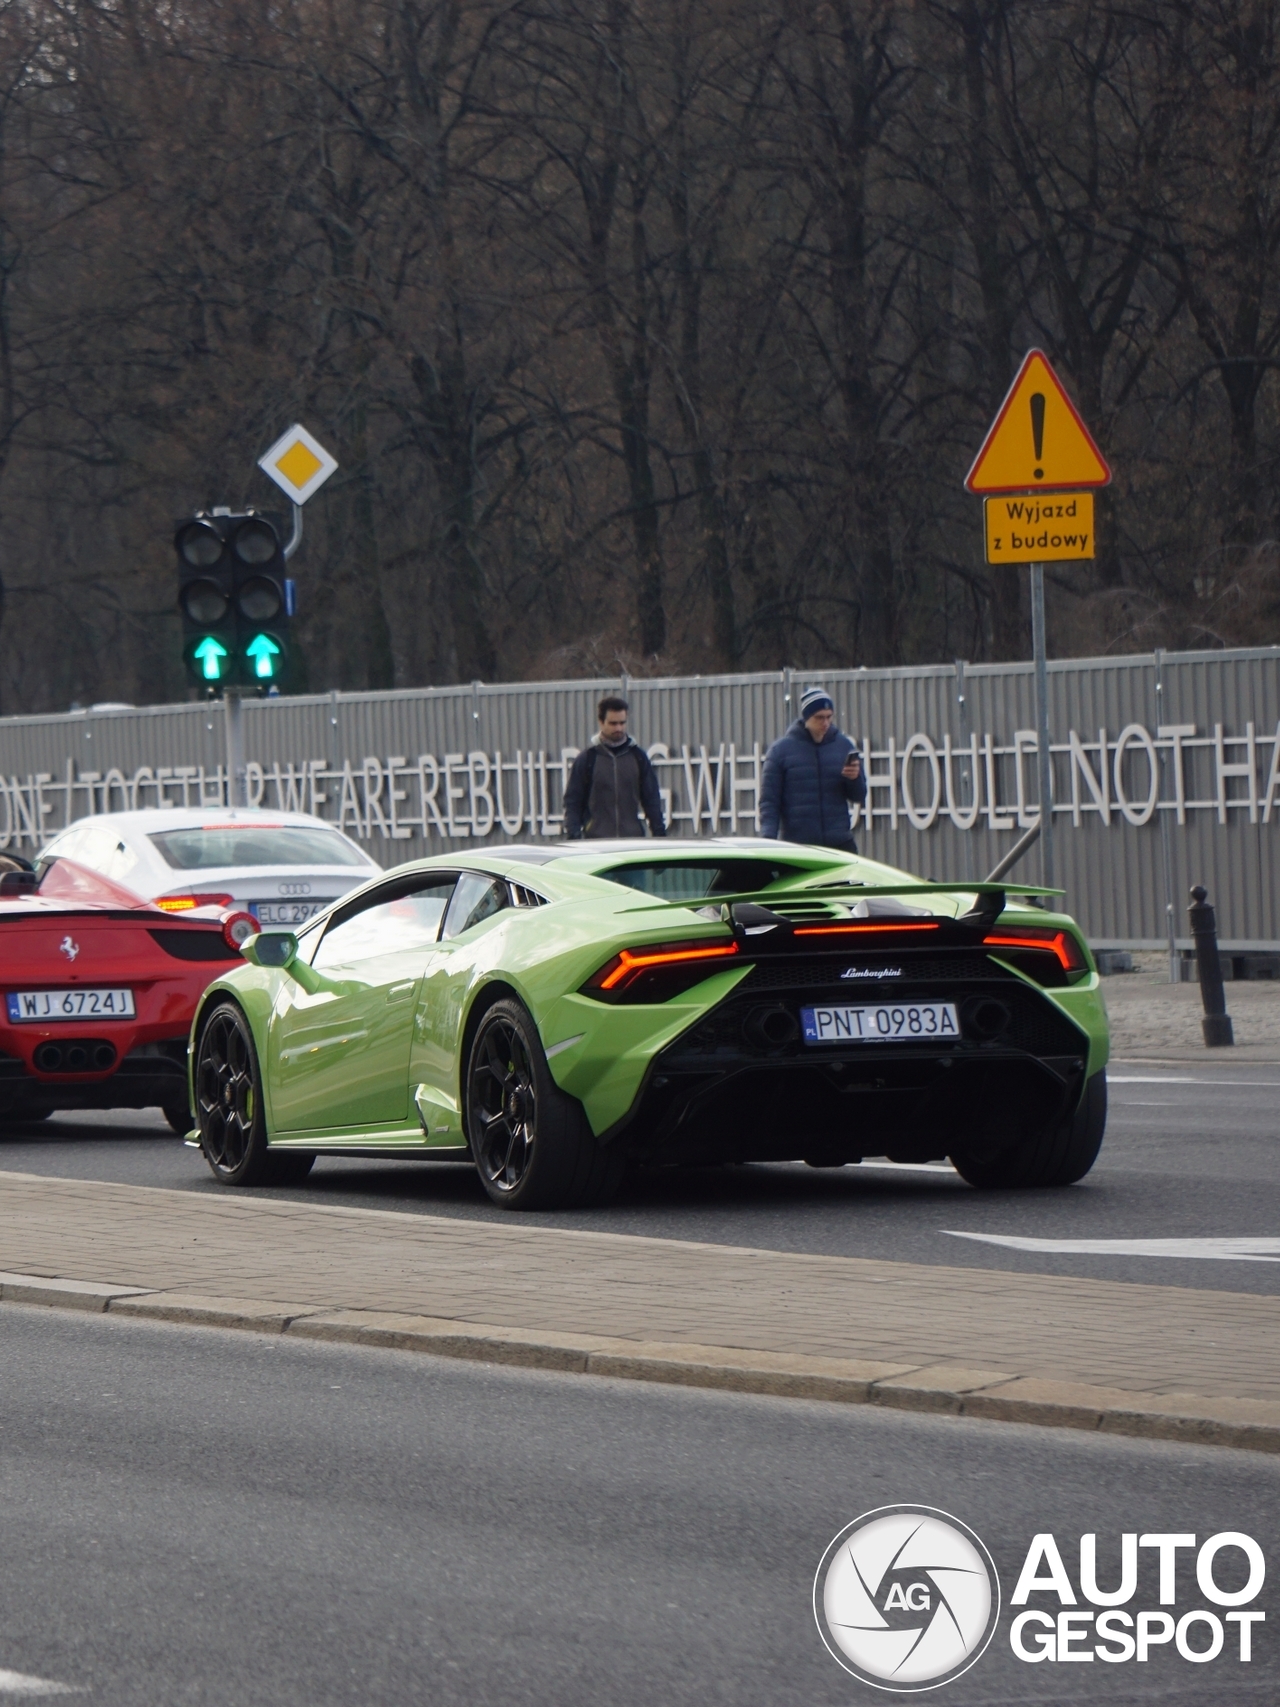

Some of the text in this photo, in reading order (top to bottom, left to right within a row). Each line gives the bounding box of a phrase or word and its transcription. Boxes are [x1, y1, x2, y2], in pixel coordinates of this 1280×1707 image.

[1006, 500, 1077, 525] Wyjazd
[993, 530, 1088, 551] z budowy
[339, 756, 412, 839] ARE
[1070, 723, 1196, 827] NOT
[840, 967, 902, 979] Lamborghini
[23, 992, 126, 1016] WJ 6724J
[806, 1028, 817, 1036] PL
[816, 1006, 956, 1037] PNT 0983A
